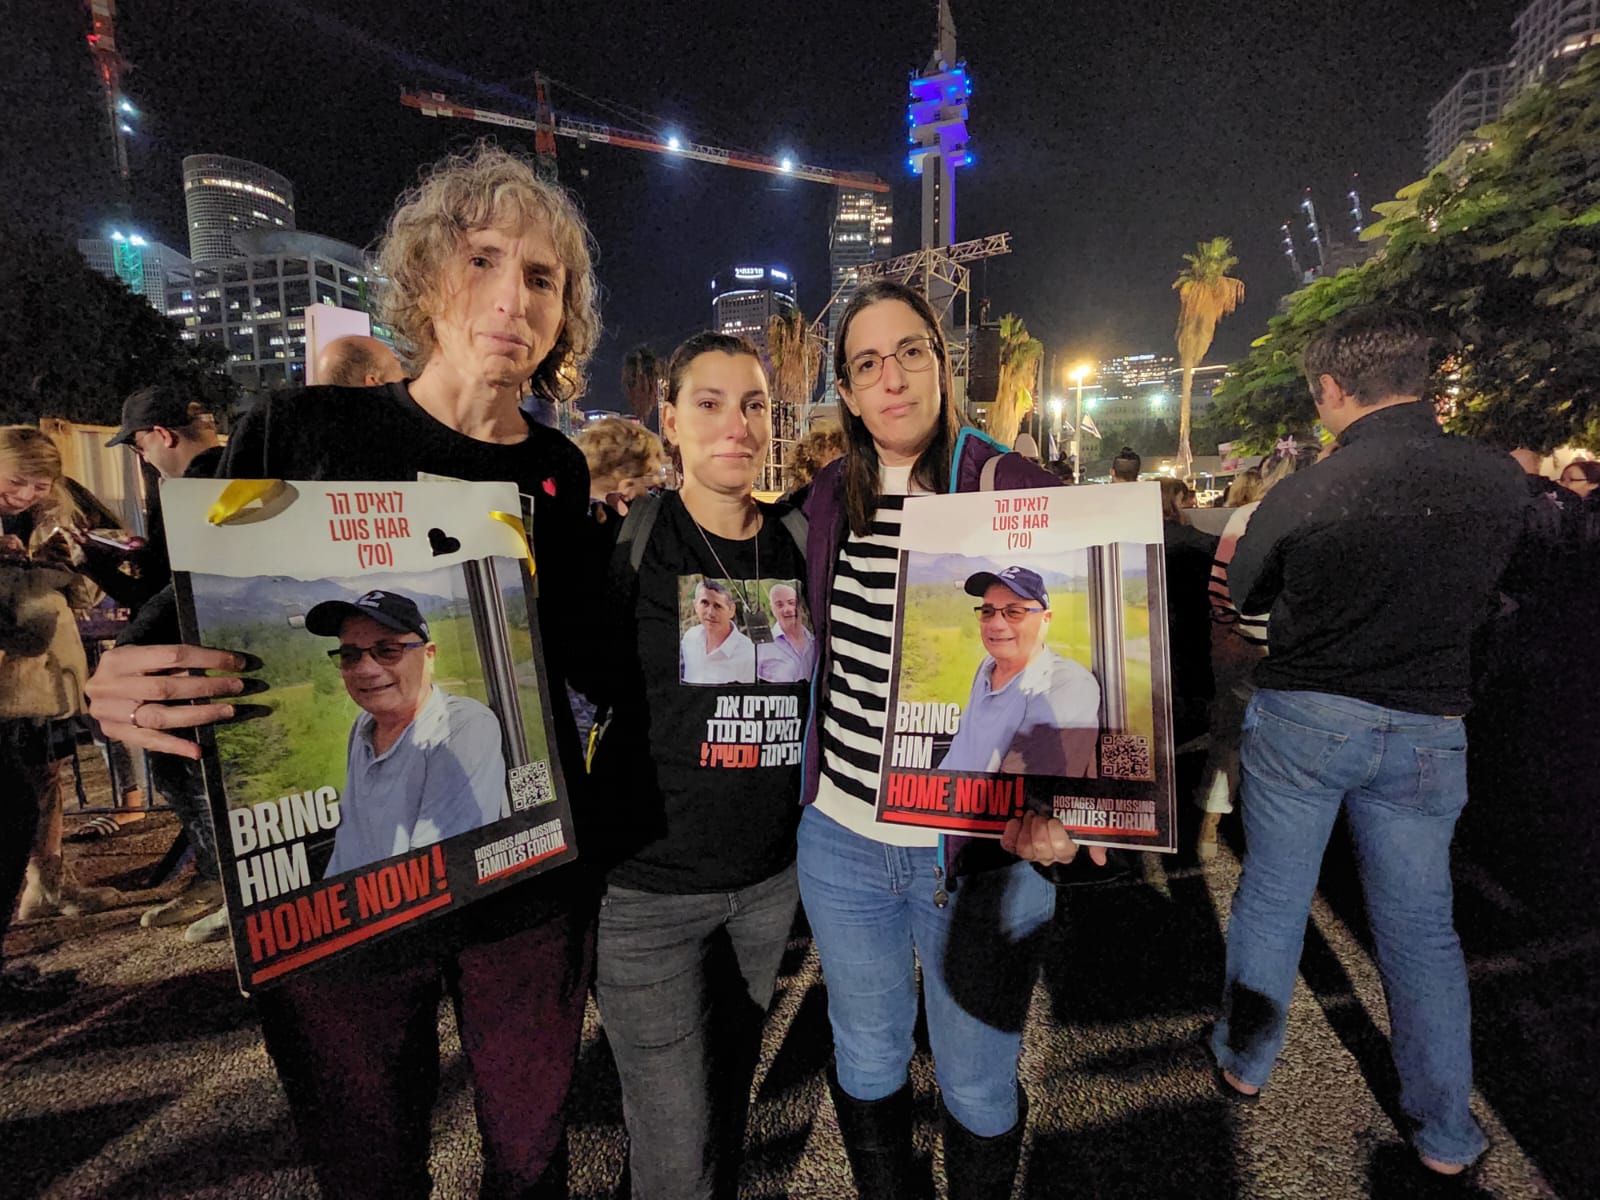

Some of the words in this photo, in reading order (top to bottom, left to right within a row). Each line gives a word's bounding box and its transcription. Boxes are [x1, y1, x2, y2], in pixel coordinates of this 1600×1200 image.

[326, 493, 350, 515] הר
[354, 491, 403, 514] לואיס
[994, 499, 1010, 513] הר
[1013, 496, 1049, 512] לואיס
[329, 517, 369, 542] LUIS
[374, 517, 411, 540] HAR
[992, 515, 1019, 531] LUIS
[1022, 513, 1049, 529] HAR
[1007, 531, 1032, 550] (70)
[358, 542, 393, 568] (70)
[714, 695, 740, 718] את
[743, 695, 798, 718] מחזירים
[894, 701, 960, 735] BRING
[707, 719, 763, 743] ופרננדו
[765, 718, 801, 742] לואיס
[700, 742, 759, 768] עכשיו!
[760, 742, 802, 767] הביתה
[891, 735, 934, 770] HIM
[886, 773, 950, 811] HOME
[954, 776, 1025, 817] NOW!
[1053, 795, 1096, 810] HOSTAGES
[1096, 798, 1114, 811] AND
[1116, 799, 1156, 813] MISSING
[228, 786, 341, 857] BRING
[1053, 808, 1107, 828] FAMILIES
[1108, 811, 1155, 832] FORUM
[474, 836, 515, 861] HOSTAGES
[514, 830, 530, 846] AND
[529, 818, 562, 840] MISSING
[477, 844, 527, 879] FAMILIES
[526, 830, 565, 859] FORUM
[236, 841, 311, 907] HIM
[246, 882, 351, 963] HOME
[355, 844, 448, 920] NOW!
